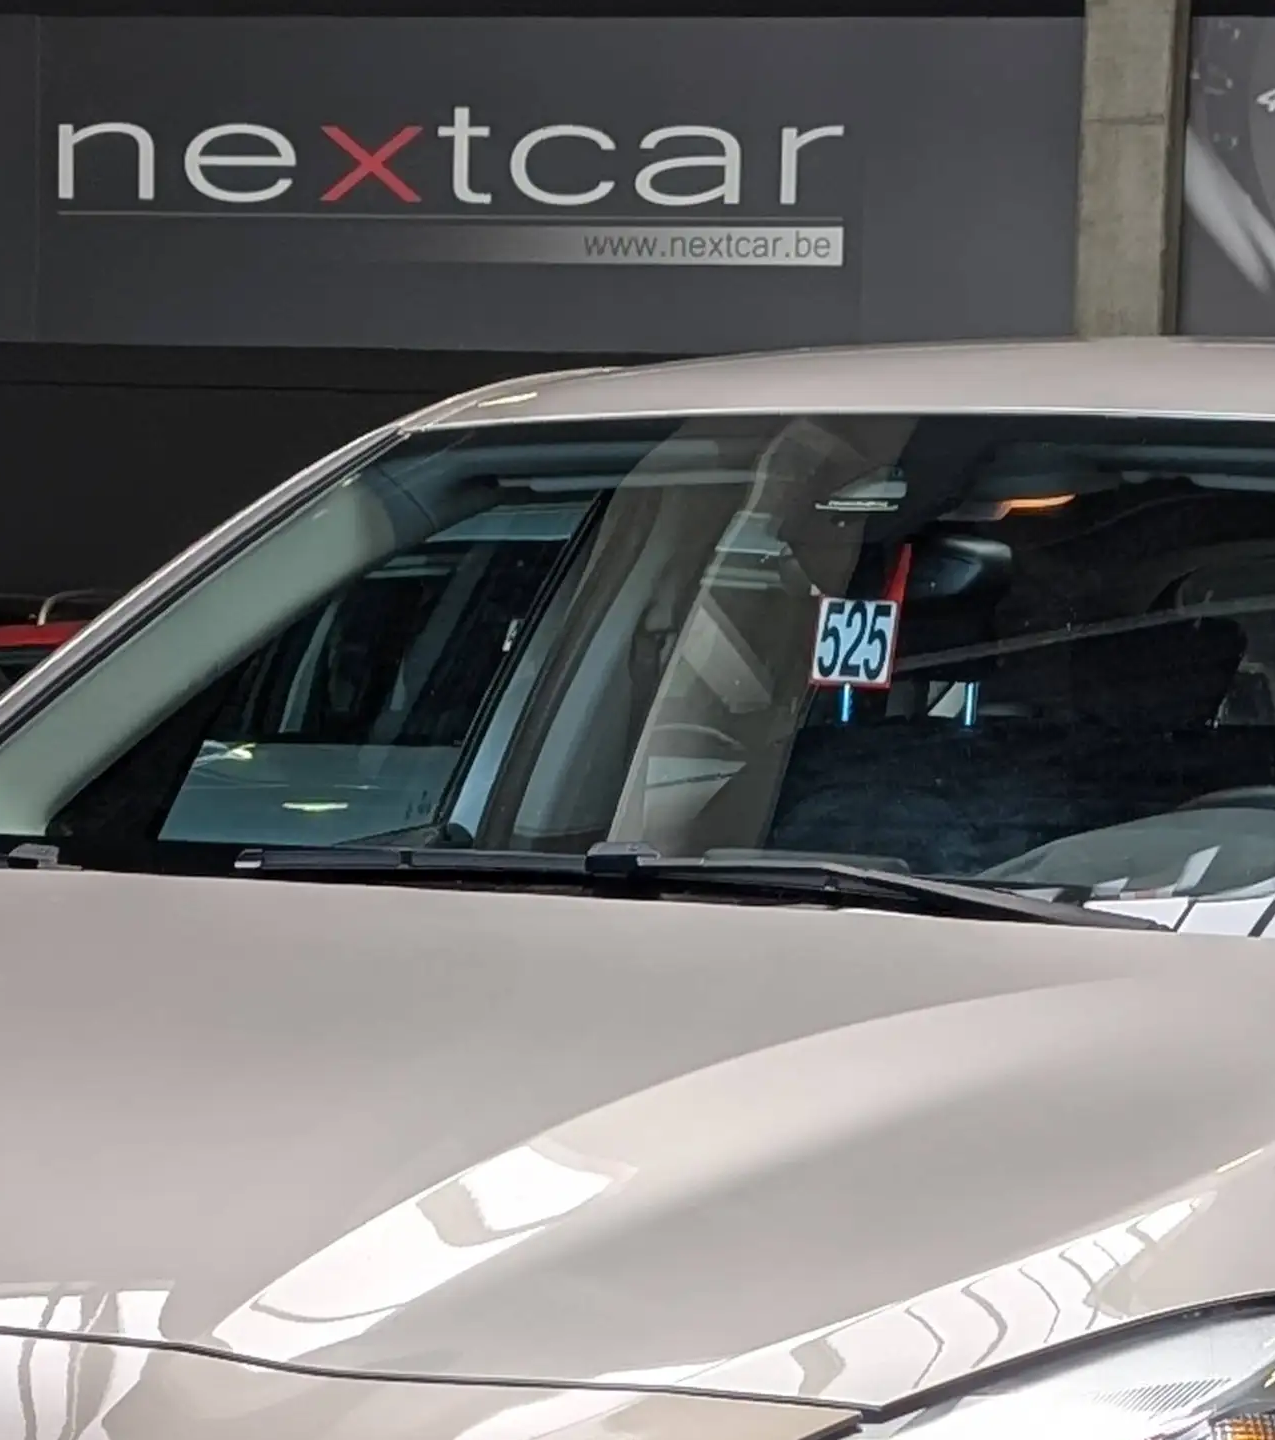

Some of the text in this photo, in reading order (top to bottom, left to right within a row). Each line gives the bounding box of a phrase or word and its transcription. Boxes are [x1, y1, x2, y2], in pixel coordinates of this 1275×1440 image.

[57, 106, 845, 206] nextcar
[582, 229, 832, 262] www.nextcar.be
[817, 600, 892, 681] 525
